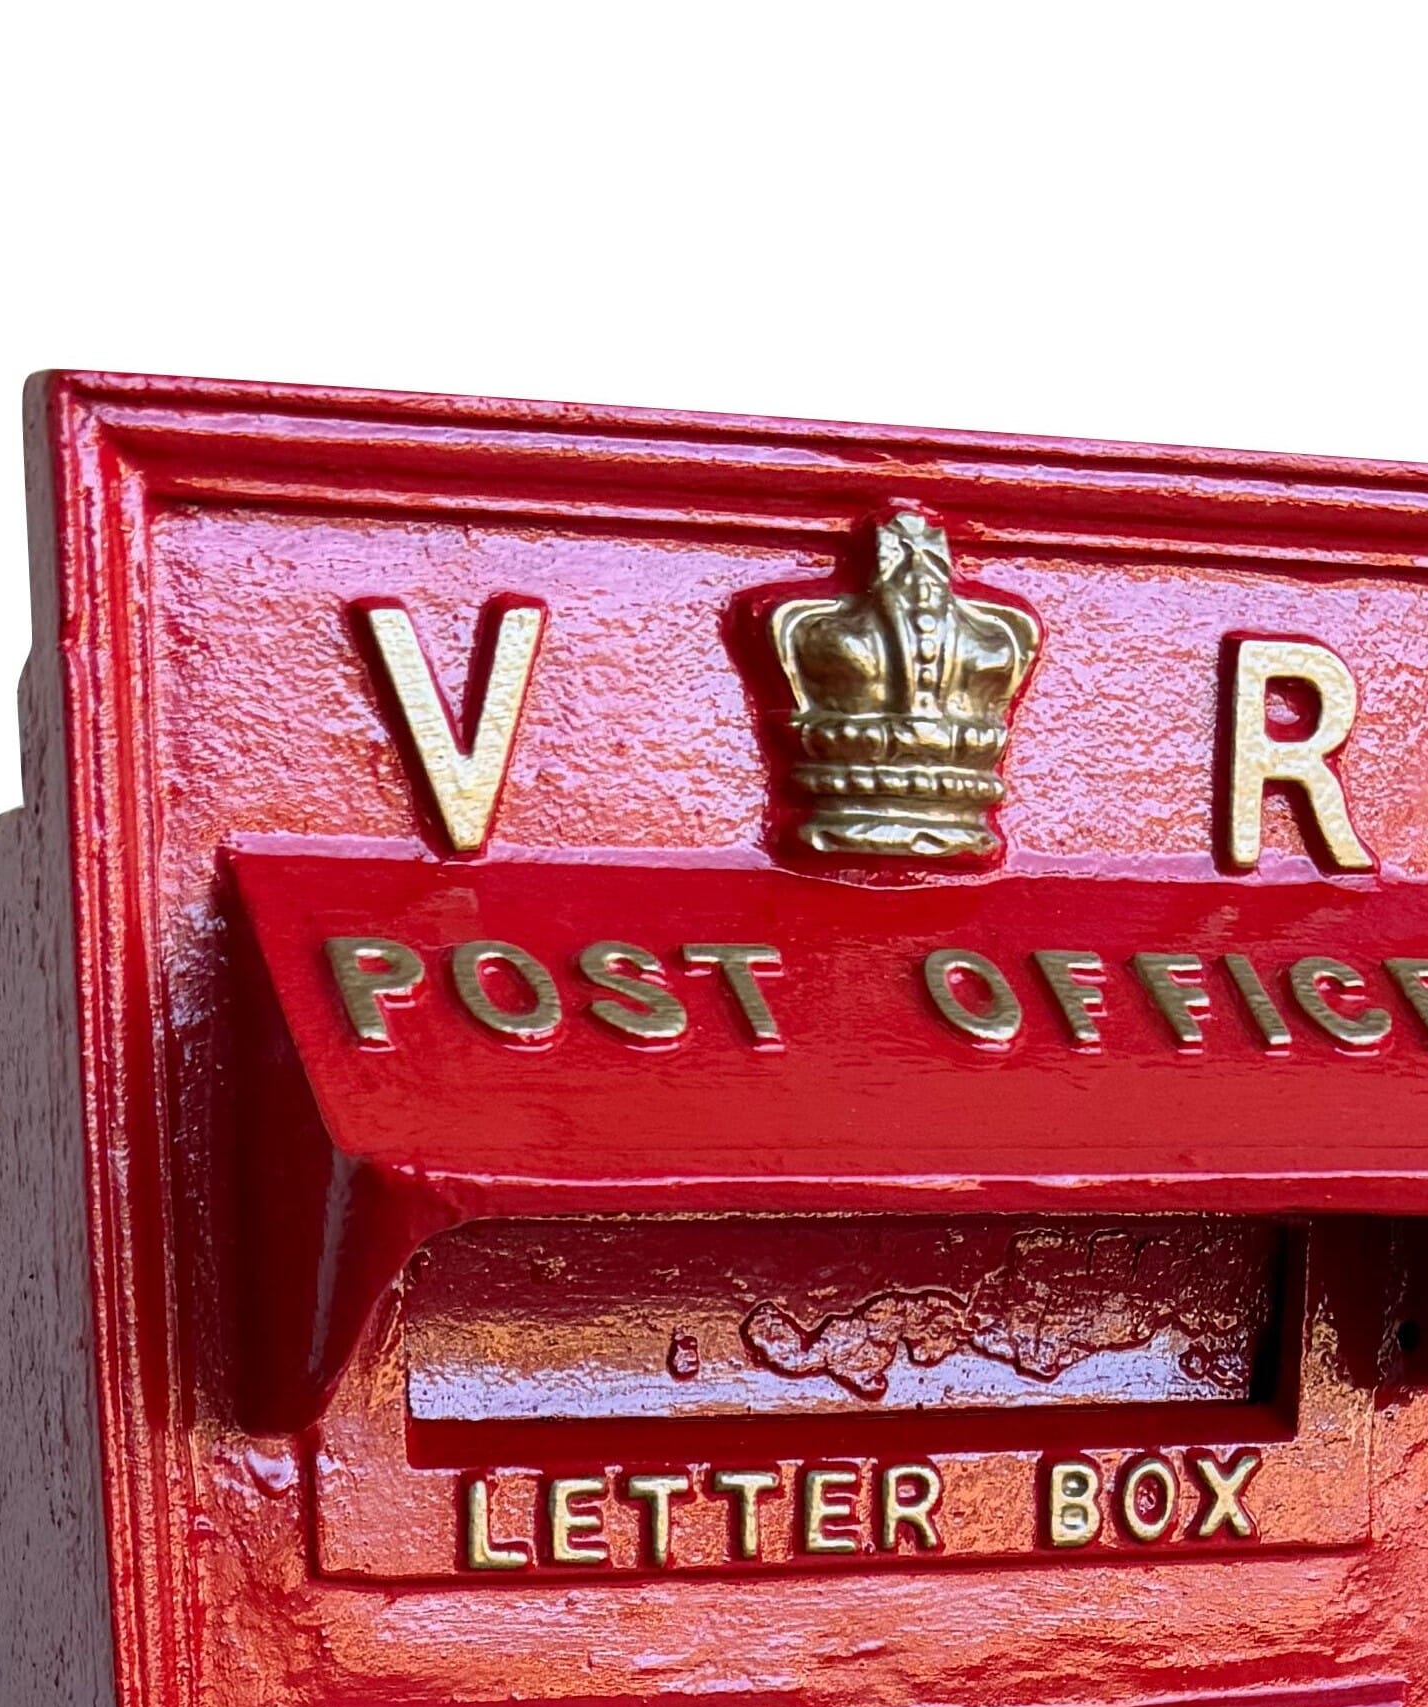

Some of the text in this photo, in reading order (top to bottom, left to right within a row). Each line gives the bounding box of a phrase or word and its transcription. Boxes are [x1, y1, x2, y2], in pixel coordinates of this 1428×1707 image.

[368, 605, 1373, 869] V R
[325, 936, 784, 1048] POST
[465, 1453, 1259, 1570] LETTER BOX
